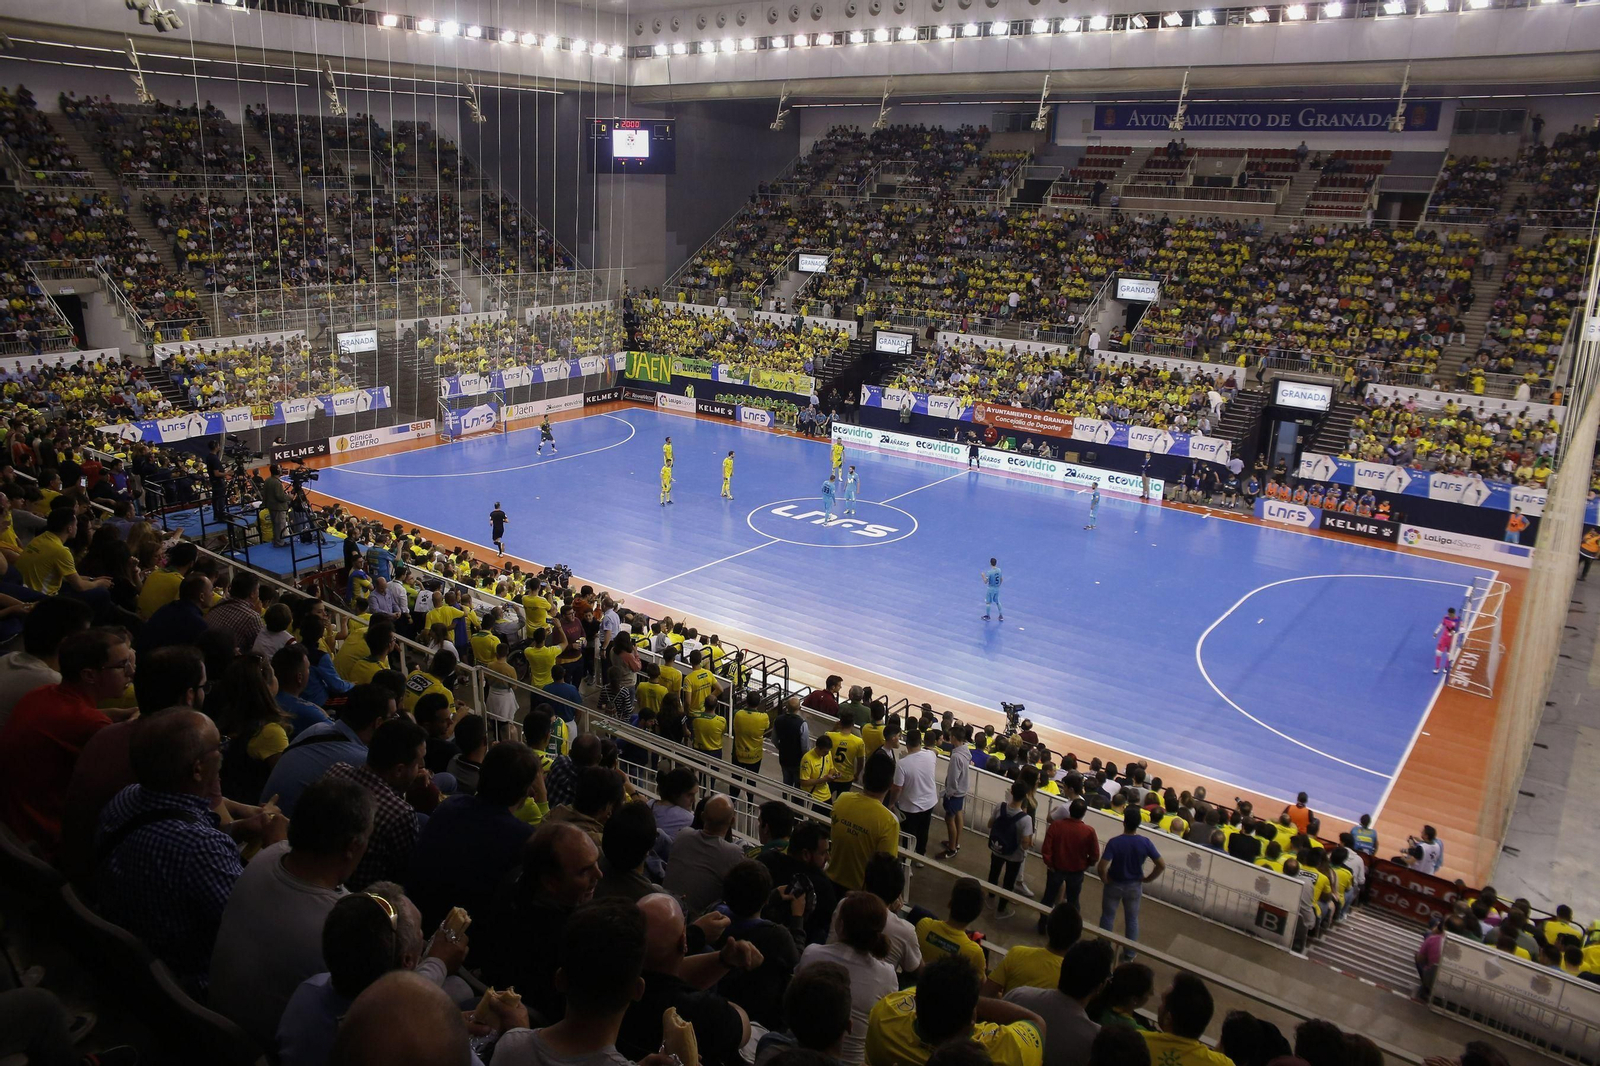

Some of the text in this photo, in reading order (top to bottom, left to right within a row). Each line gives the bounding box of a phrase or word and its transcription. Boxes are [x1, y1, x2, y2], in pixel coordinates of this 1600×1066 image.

[1127, 108, 1393, 127] AYUNAMIENTO DE GRANADA
[801, 259, 826, 267] GRANAD
[1120, 285, 1156, 294] GRANADA
[341, 337, 375, 347] GRANADA
[626, 351, 672, 382] JAEN
[586, 392, 613, 403] KELME
[1281, 389, 1327, 402] GRANADA
[514, 404, 535, 416] Jaén
[699, 403, 726, 415] KELME
[986, 406, 1033, 419] AYUNTAMIENTO
[1043, 415, 1073, 427] GRANADA
[411, 421, 431, 431] SEUR
[833, 425, 873, 440] ecovidrio
[350, 438, 379, 449] CEMTRO
[916, 440, 961, 456] ecovidrio
[274, 446, 315, 461] KELME
[1007, 456, 1056, 474] ecovidrio
[1108, 475, 1162, 492] ecoviio
[1325, 517, 1379, 535] KELME
[1450, 652, 1481, 689] KELME
[834, 747, 848, 763] 5
[1262, 912, 1280, 932] B
